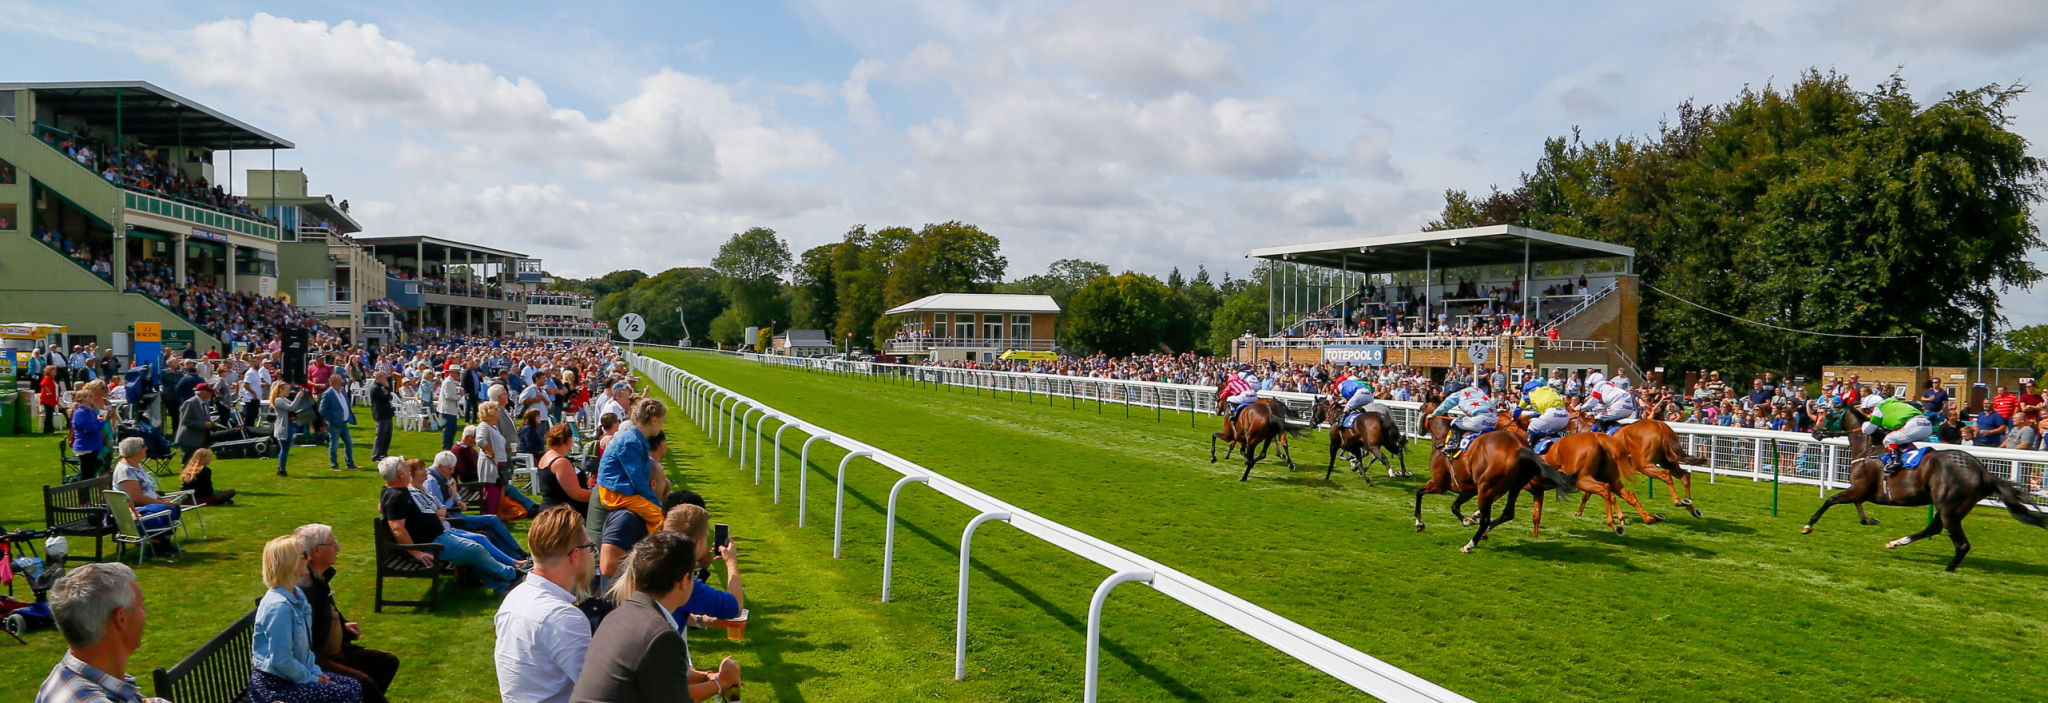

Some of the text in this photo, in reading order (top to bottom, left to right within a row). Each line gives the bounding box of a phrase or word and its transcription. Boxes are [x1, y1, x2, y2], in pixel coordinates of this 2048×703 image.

[624, 315, 639, 332] 1/2
[1326, 350, 1373, 361] TOTEPOOL
[1473, 345, 1485, 360] 1/2
[1907, 450, 1920, 464] 7
